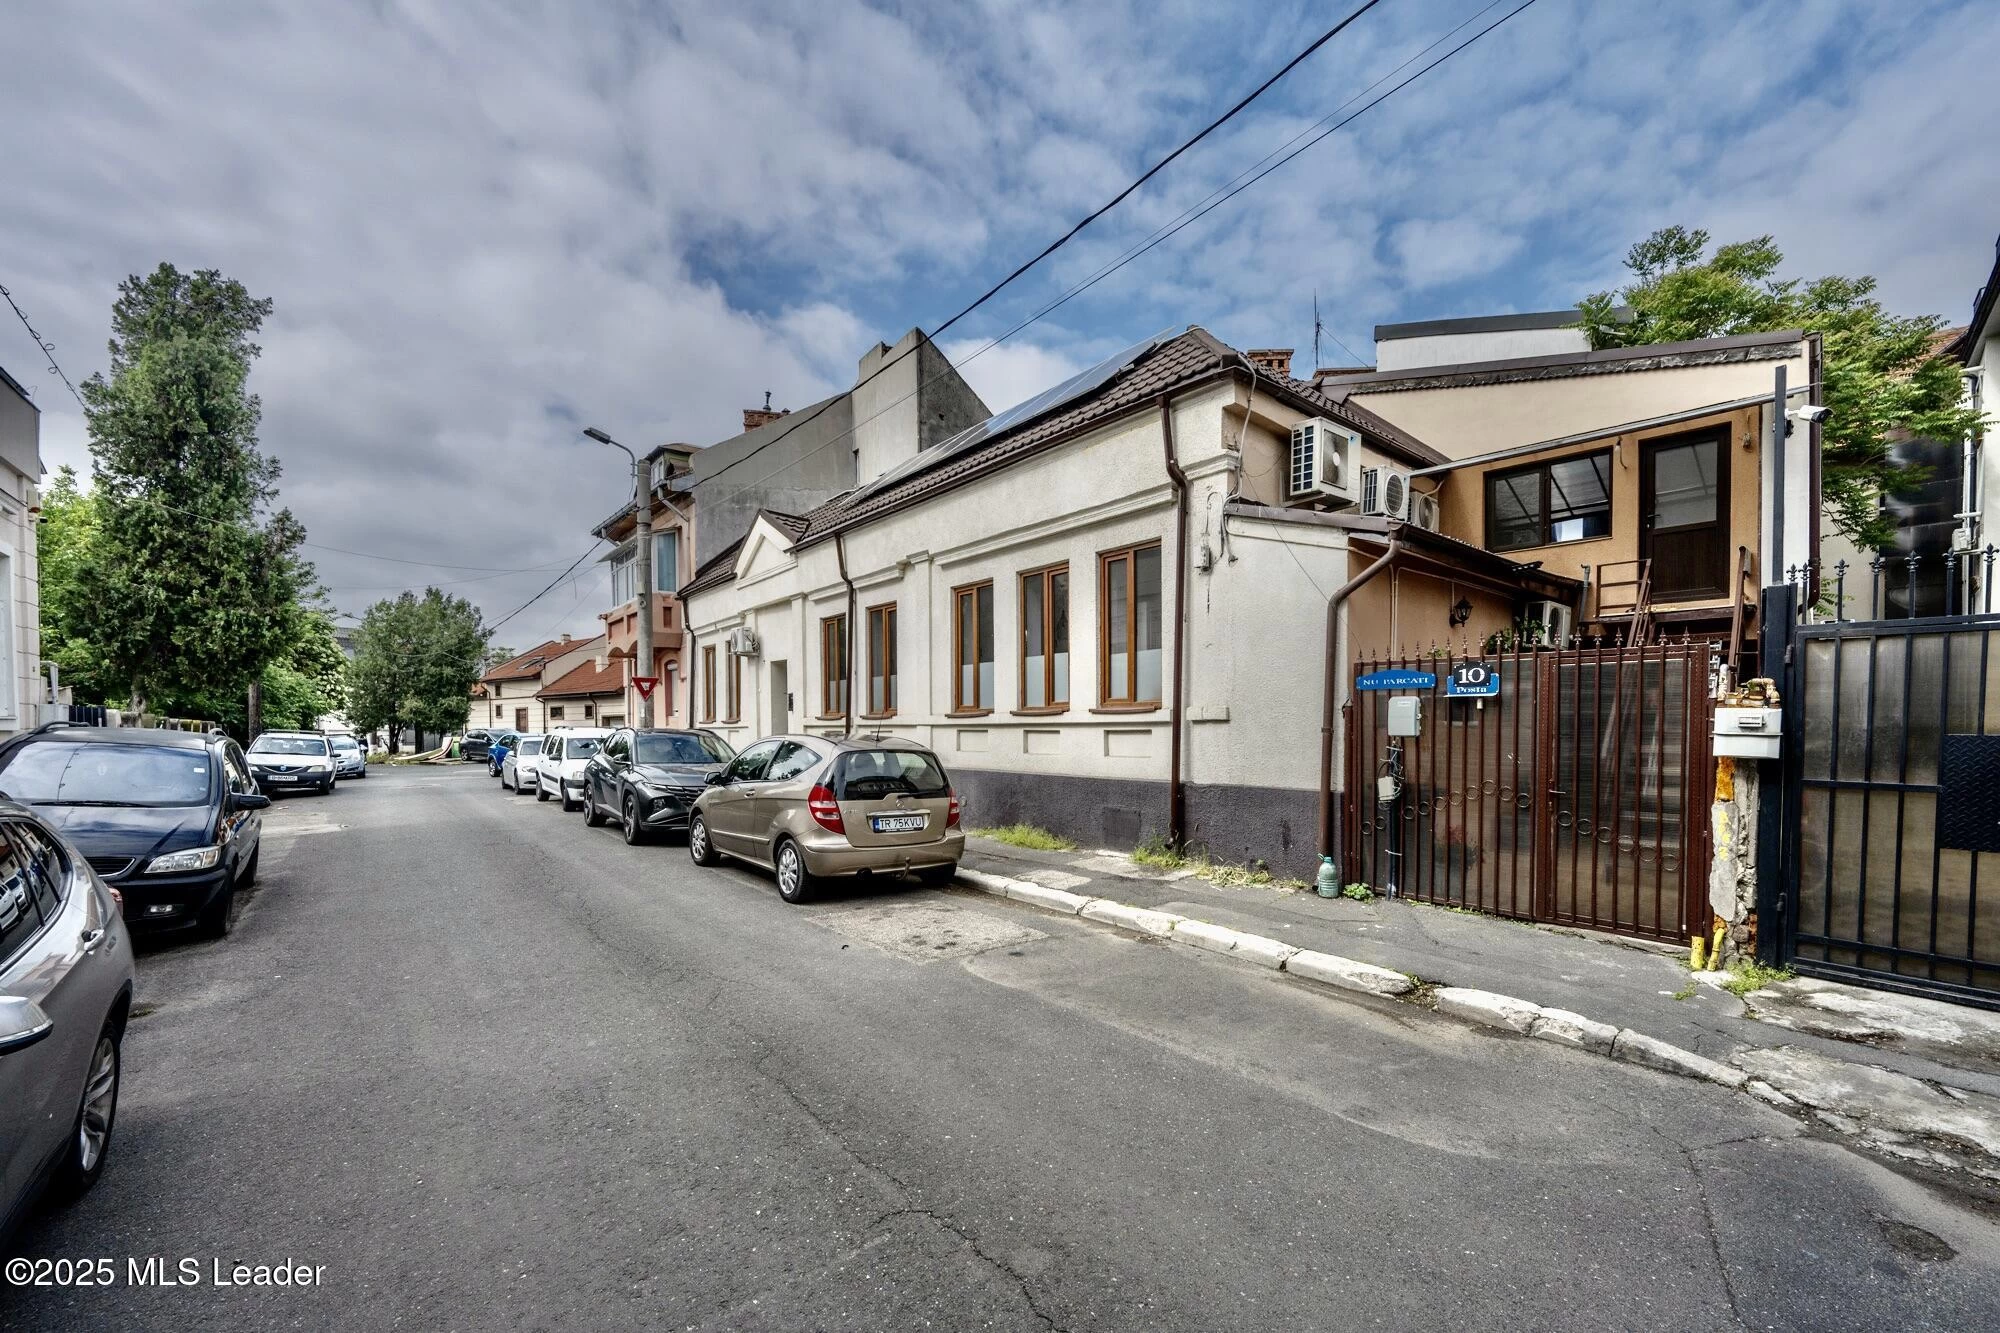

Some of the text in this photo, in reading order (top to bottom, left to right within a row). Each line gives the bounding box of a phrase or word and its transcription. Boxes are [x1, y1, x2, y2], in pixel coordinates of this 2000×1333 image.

[1383, 677, 1429, 685] PARCATI
[1458, 667, 1486, 684] 10
[880, 817, 922, 828] TR 75KVU
